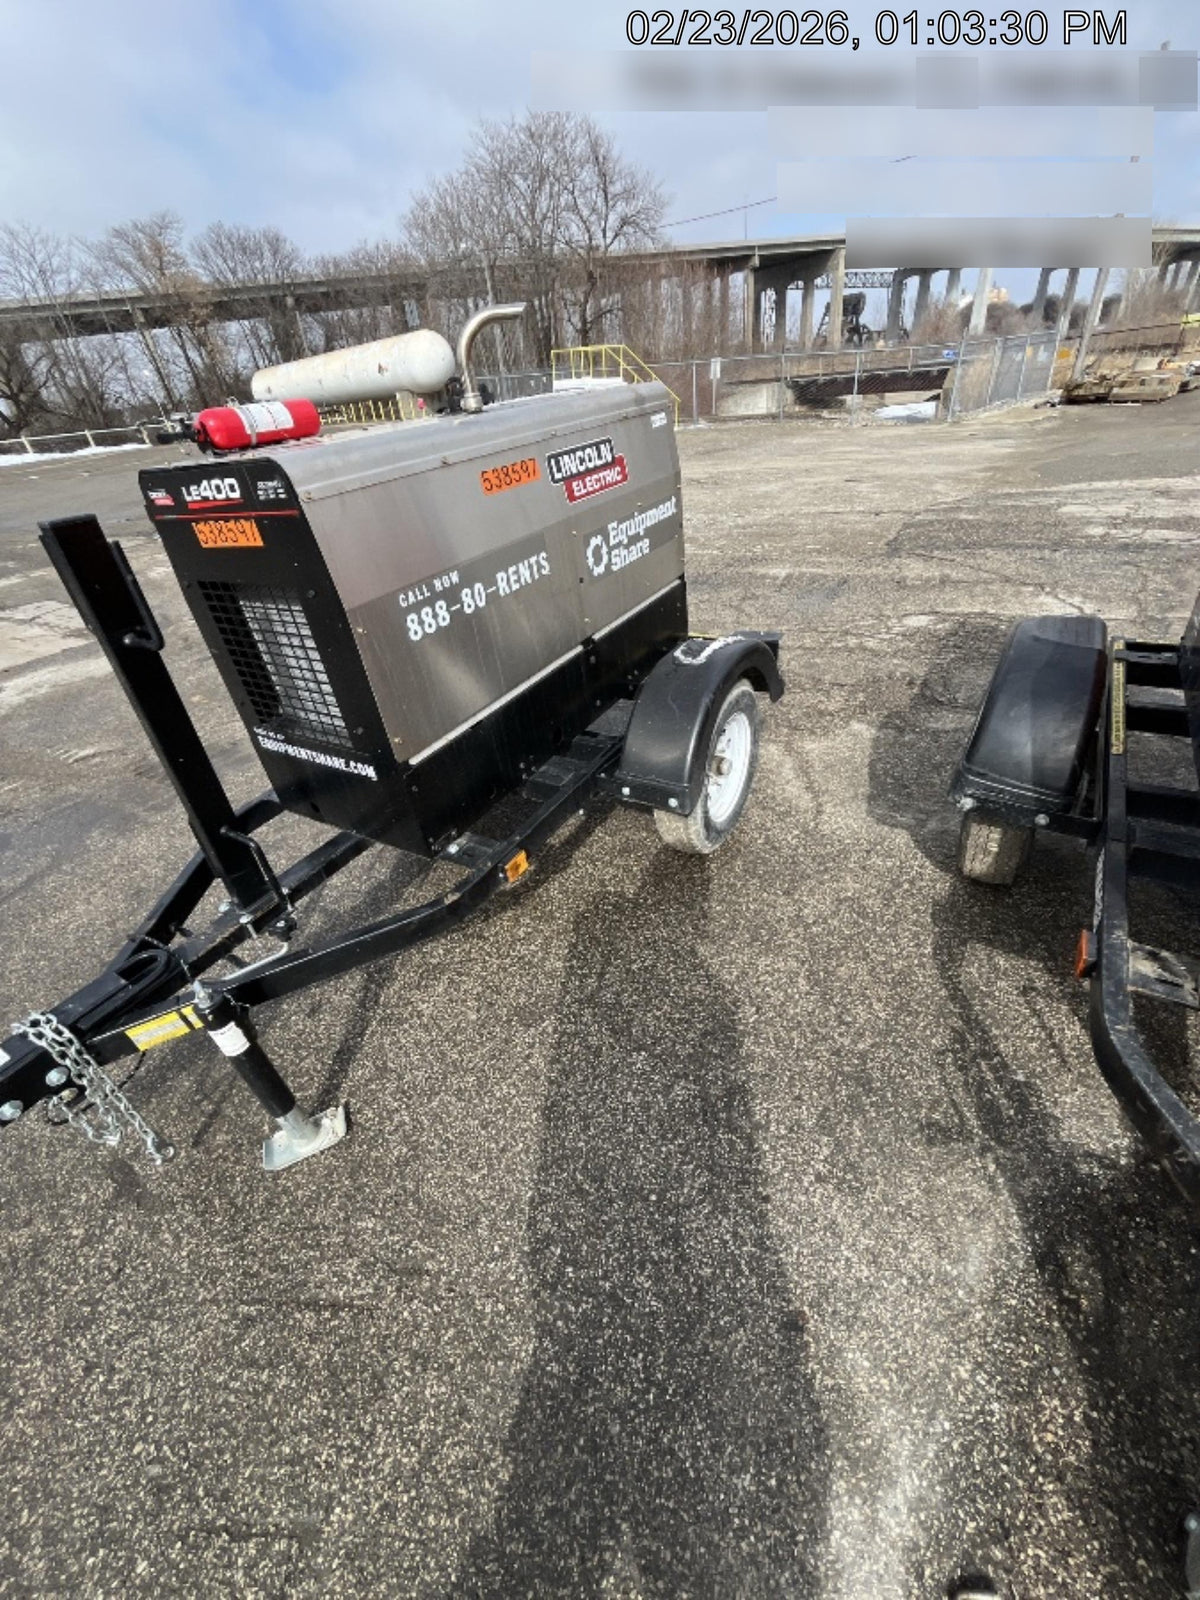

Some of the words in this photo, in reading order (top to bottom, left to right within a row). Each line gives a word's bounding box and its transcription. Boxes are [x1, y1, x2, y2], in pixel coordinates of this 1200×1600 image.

[480, 457, 538, 492] 538597
[550, 441, 612, 479] LINCOLN
[181, 477, 241, 502] LE400
[571, 466, 623, 497] ELECTRIC
[607, 495, 676, 546] Equipment
[610, 538, 651, 572] Share
[399, 583, 431, 607] CALL
[433, 570, 460, 592] NOW
[406, 551, 550, 641] 888-80-RENTS
